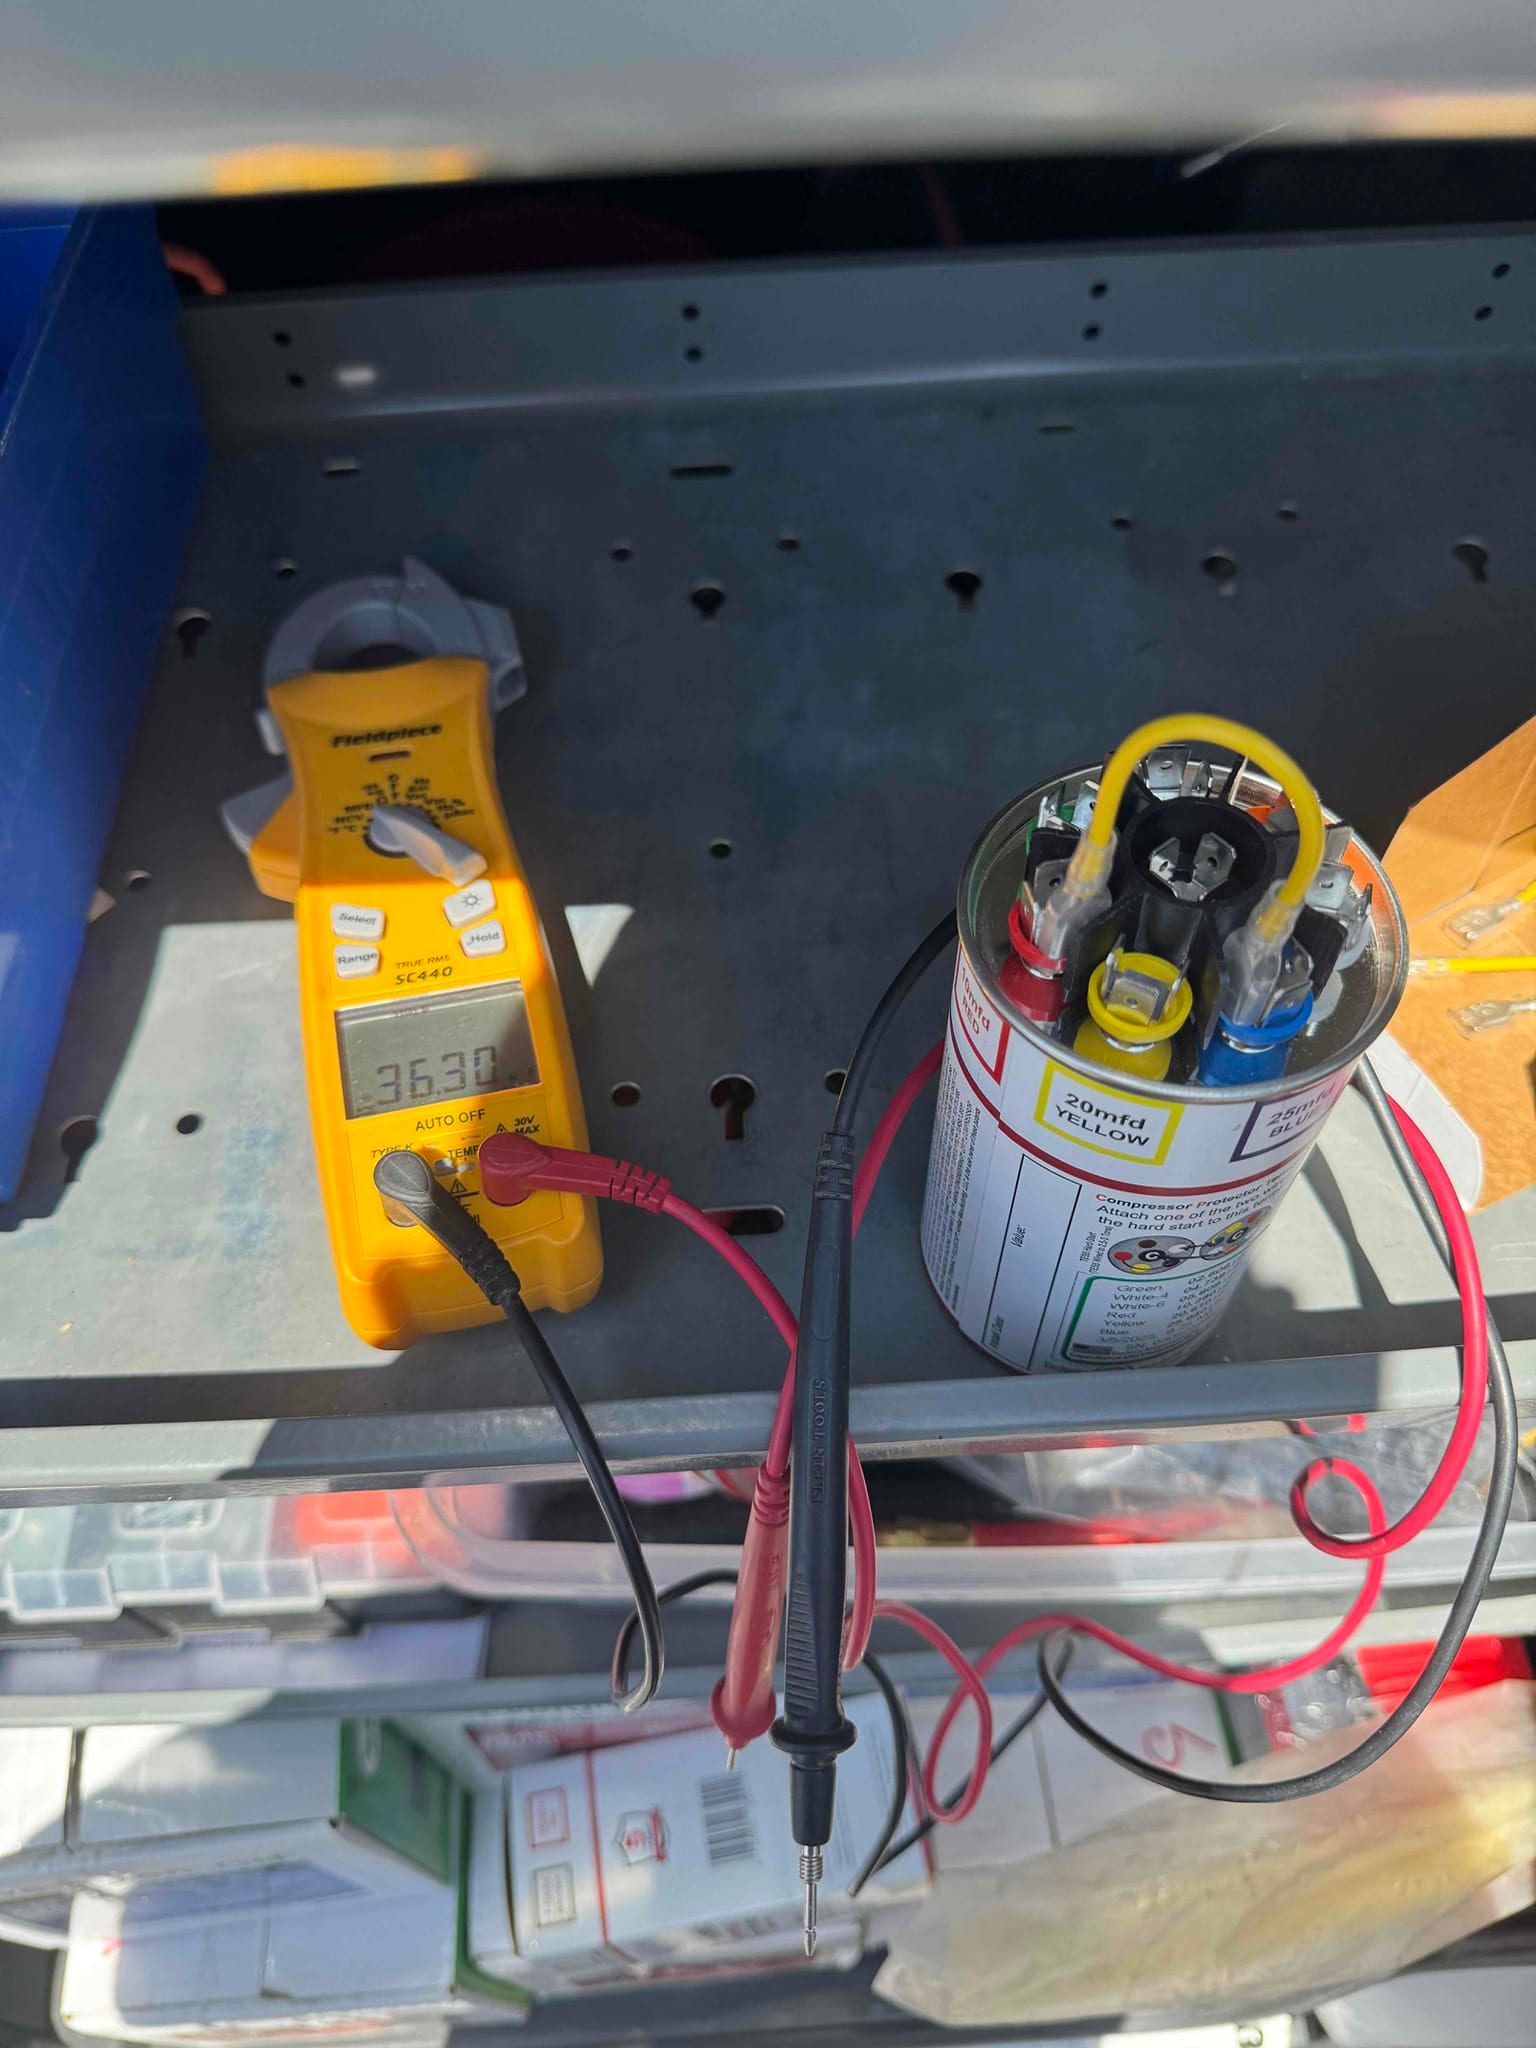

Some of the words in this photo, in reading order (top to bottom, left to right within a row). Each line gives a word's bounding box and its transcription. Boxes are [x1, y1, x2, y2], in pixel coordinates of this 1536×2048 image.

[332, 723, 443, 748] Fieldpiece
[338, 912, 377, 925] Select
[470, 932, 500, 943] Hold
[337, 953, 377, 966] Range
[395, 958, 424, 969] TRUE
[427, 954, 451, 965] RMS
[395, 966, 453, 985] SC440
[377, 1045, 497, 1106] 36.30
[1065, 1093, 1147, 1130] 20mfd
[1266, 1081, 1337, 1127] 25mfd
[416, 1115, 454, 1132] AUTO
[458, 1108, 486, 1123] OFF
[514, 1115, 535, 1127] 30V
[515, 1124, 540, 1135] MAX
[1055, 1104, 1150, 1146] YELLOW
[1268, 1108, 1320, 1138] BLUE
[1095, 1193, 1193, 1211] Compressor
[1196, 1184, 1263, 1209] Protector
[1096, 1205, 1149, 1221] Attach
[1154, 1213, 1185, 1221] one
[1188, 1209, 1206, 1219] of
[1208, 1204, 1232, 1216] the
[1235, 1194, 1260, 1208] two
[1098, 1215, 1123, 1228] the
[1128, 1221, 1165, 1231] hard
[1168, 1219, 1204, 1231] start
[1208, 1217, 1221, 1225] to
[1010, 1223, 1027, 1248] Value:
[1113, 1291, 1169, 1301] White-4
[1103, 1319, 1147, 1327] Yellow
